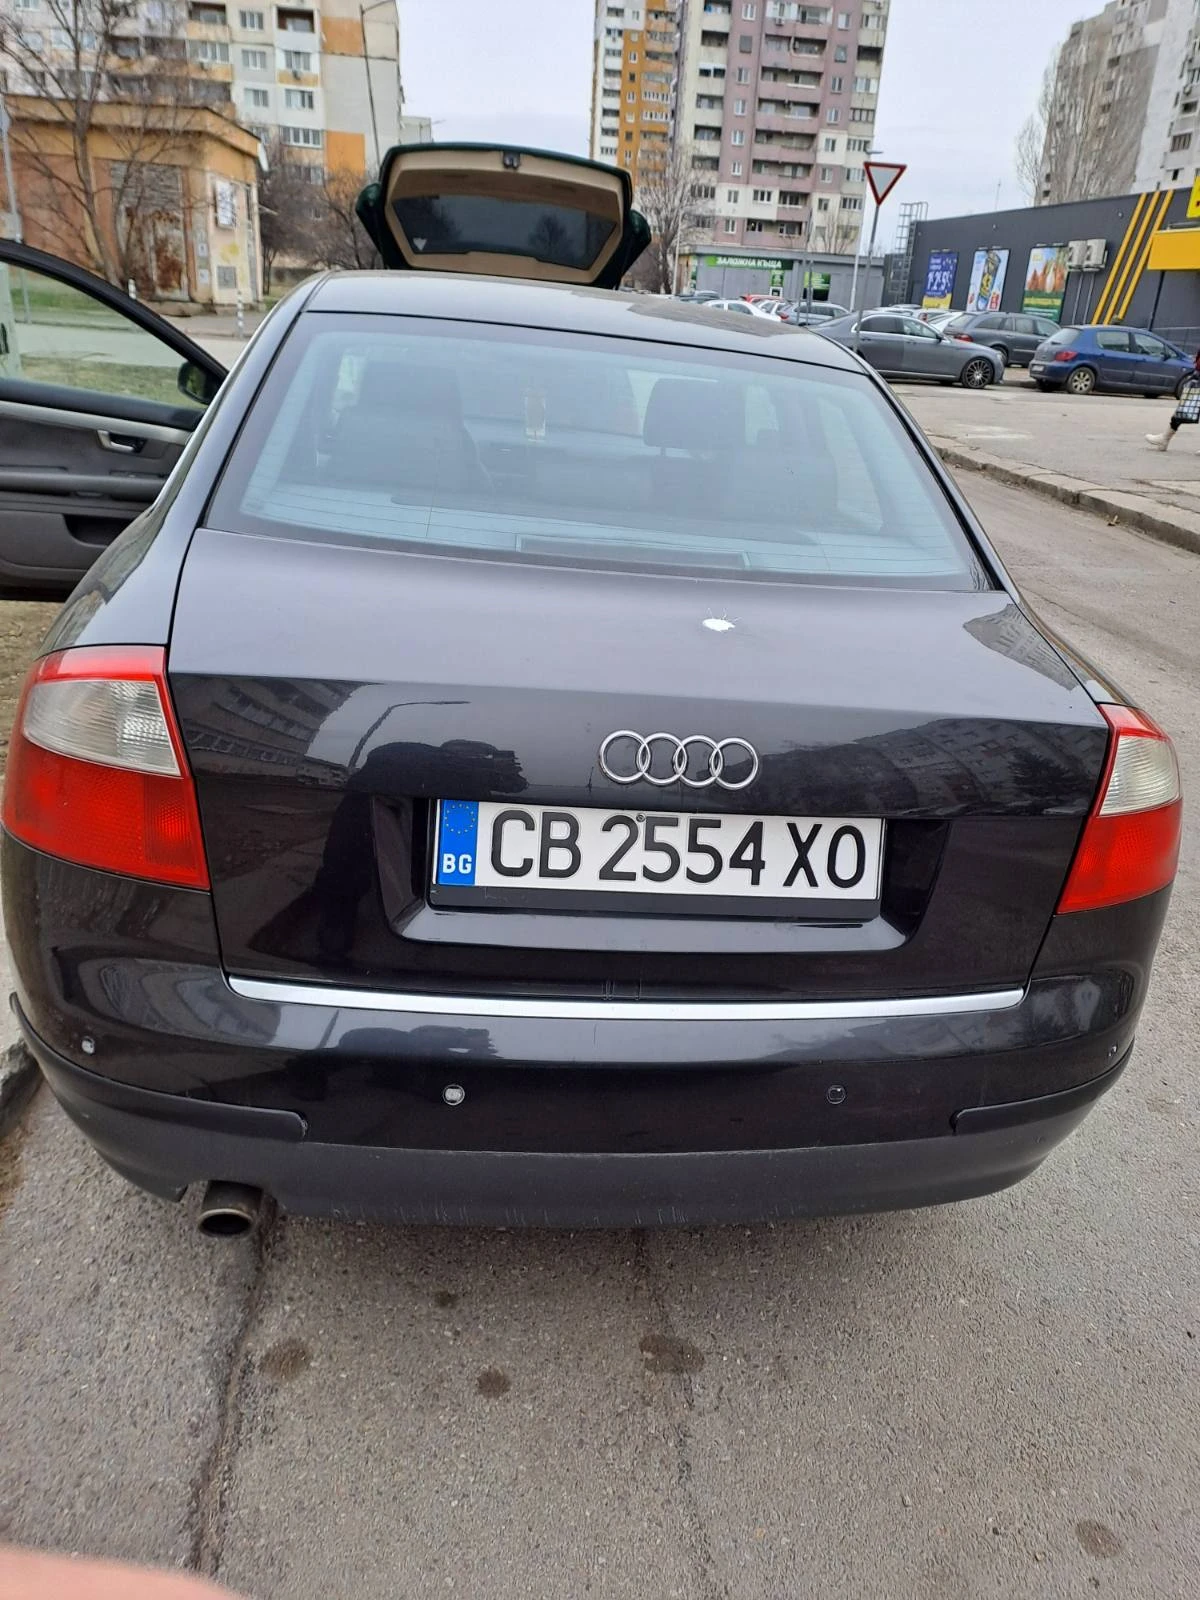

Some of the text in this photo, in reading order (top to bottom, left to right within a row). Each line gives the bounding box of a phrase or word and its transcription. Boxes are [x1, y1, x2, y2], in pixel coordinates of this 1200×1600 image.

[757, 259, 782, 268] КЪЩА
[490, 808, 582, 879] CB
[598, 814, 766, 886] 2554
[442, 853, 473, 874] BG
